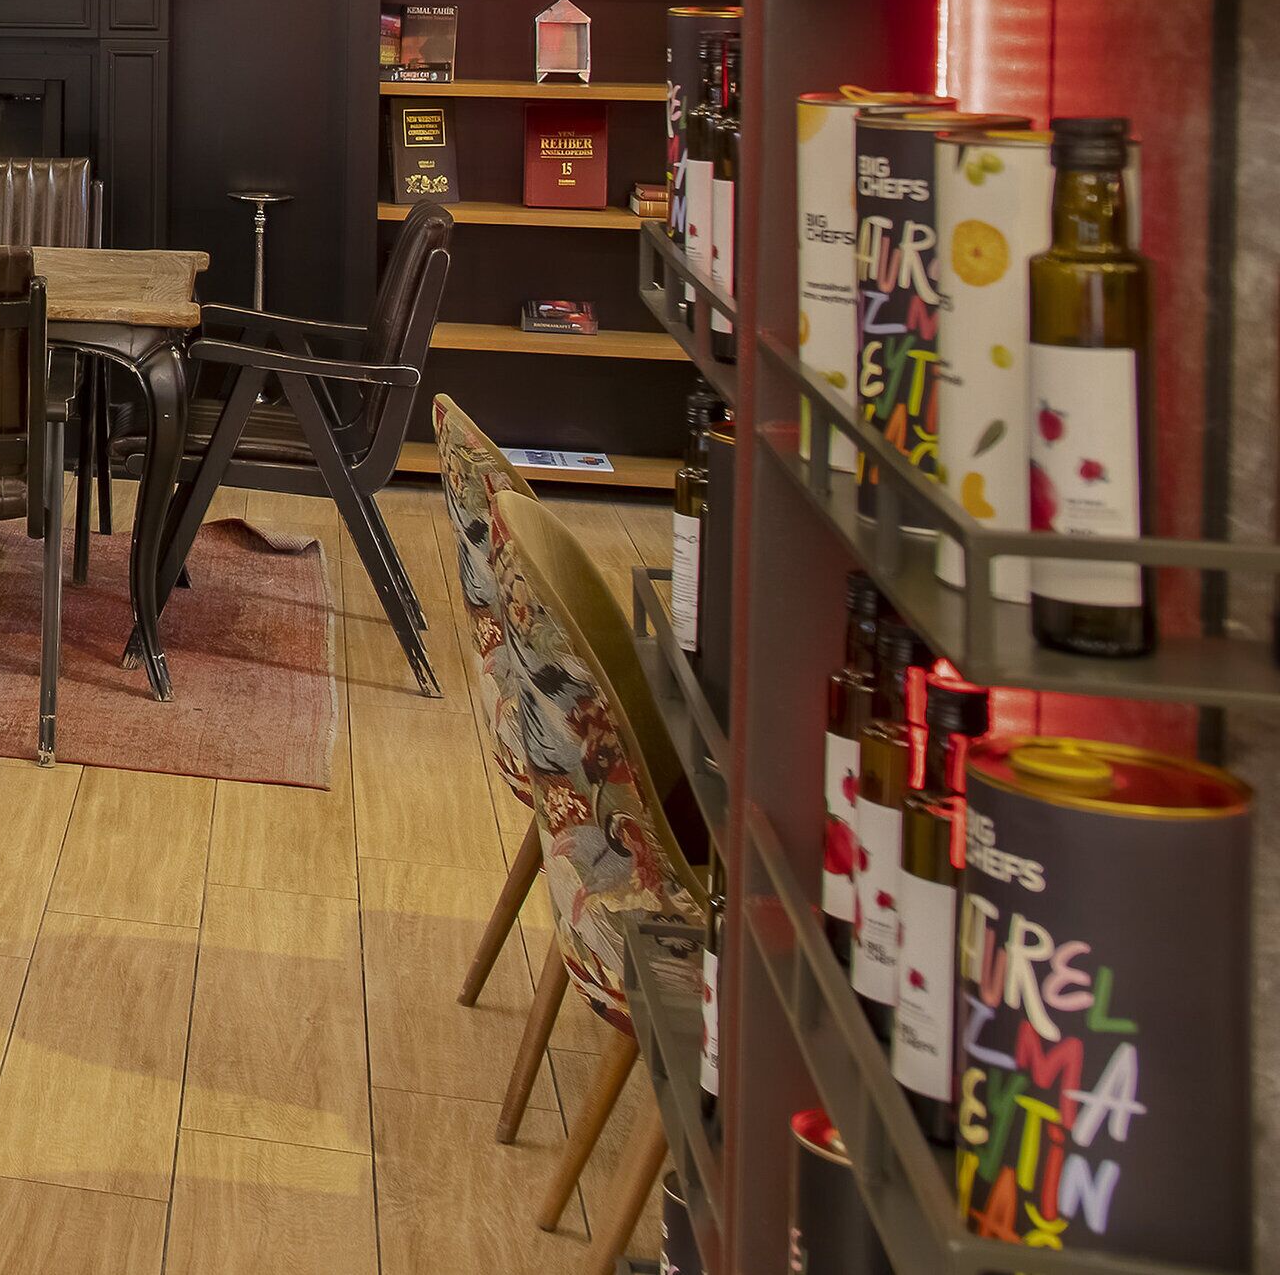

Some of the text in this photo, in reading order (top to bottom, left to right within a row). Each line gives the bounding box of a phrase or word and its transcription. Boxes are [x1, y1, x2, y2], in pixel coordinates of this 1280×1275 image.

[432, 7, 455, 15] TAHİR
[540, 138, 592, 149] REHBER
[562, 163, 572, 175] 15
[858, 177, 929, 201] CHEFS
